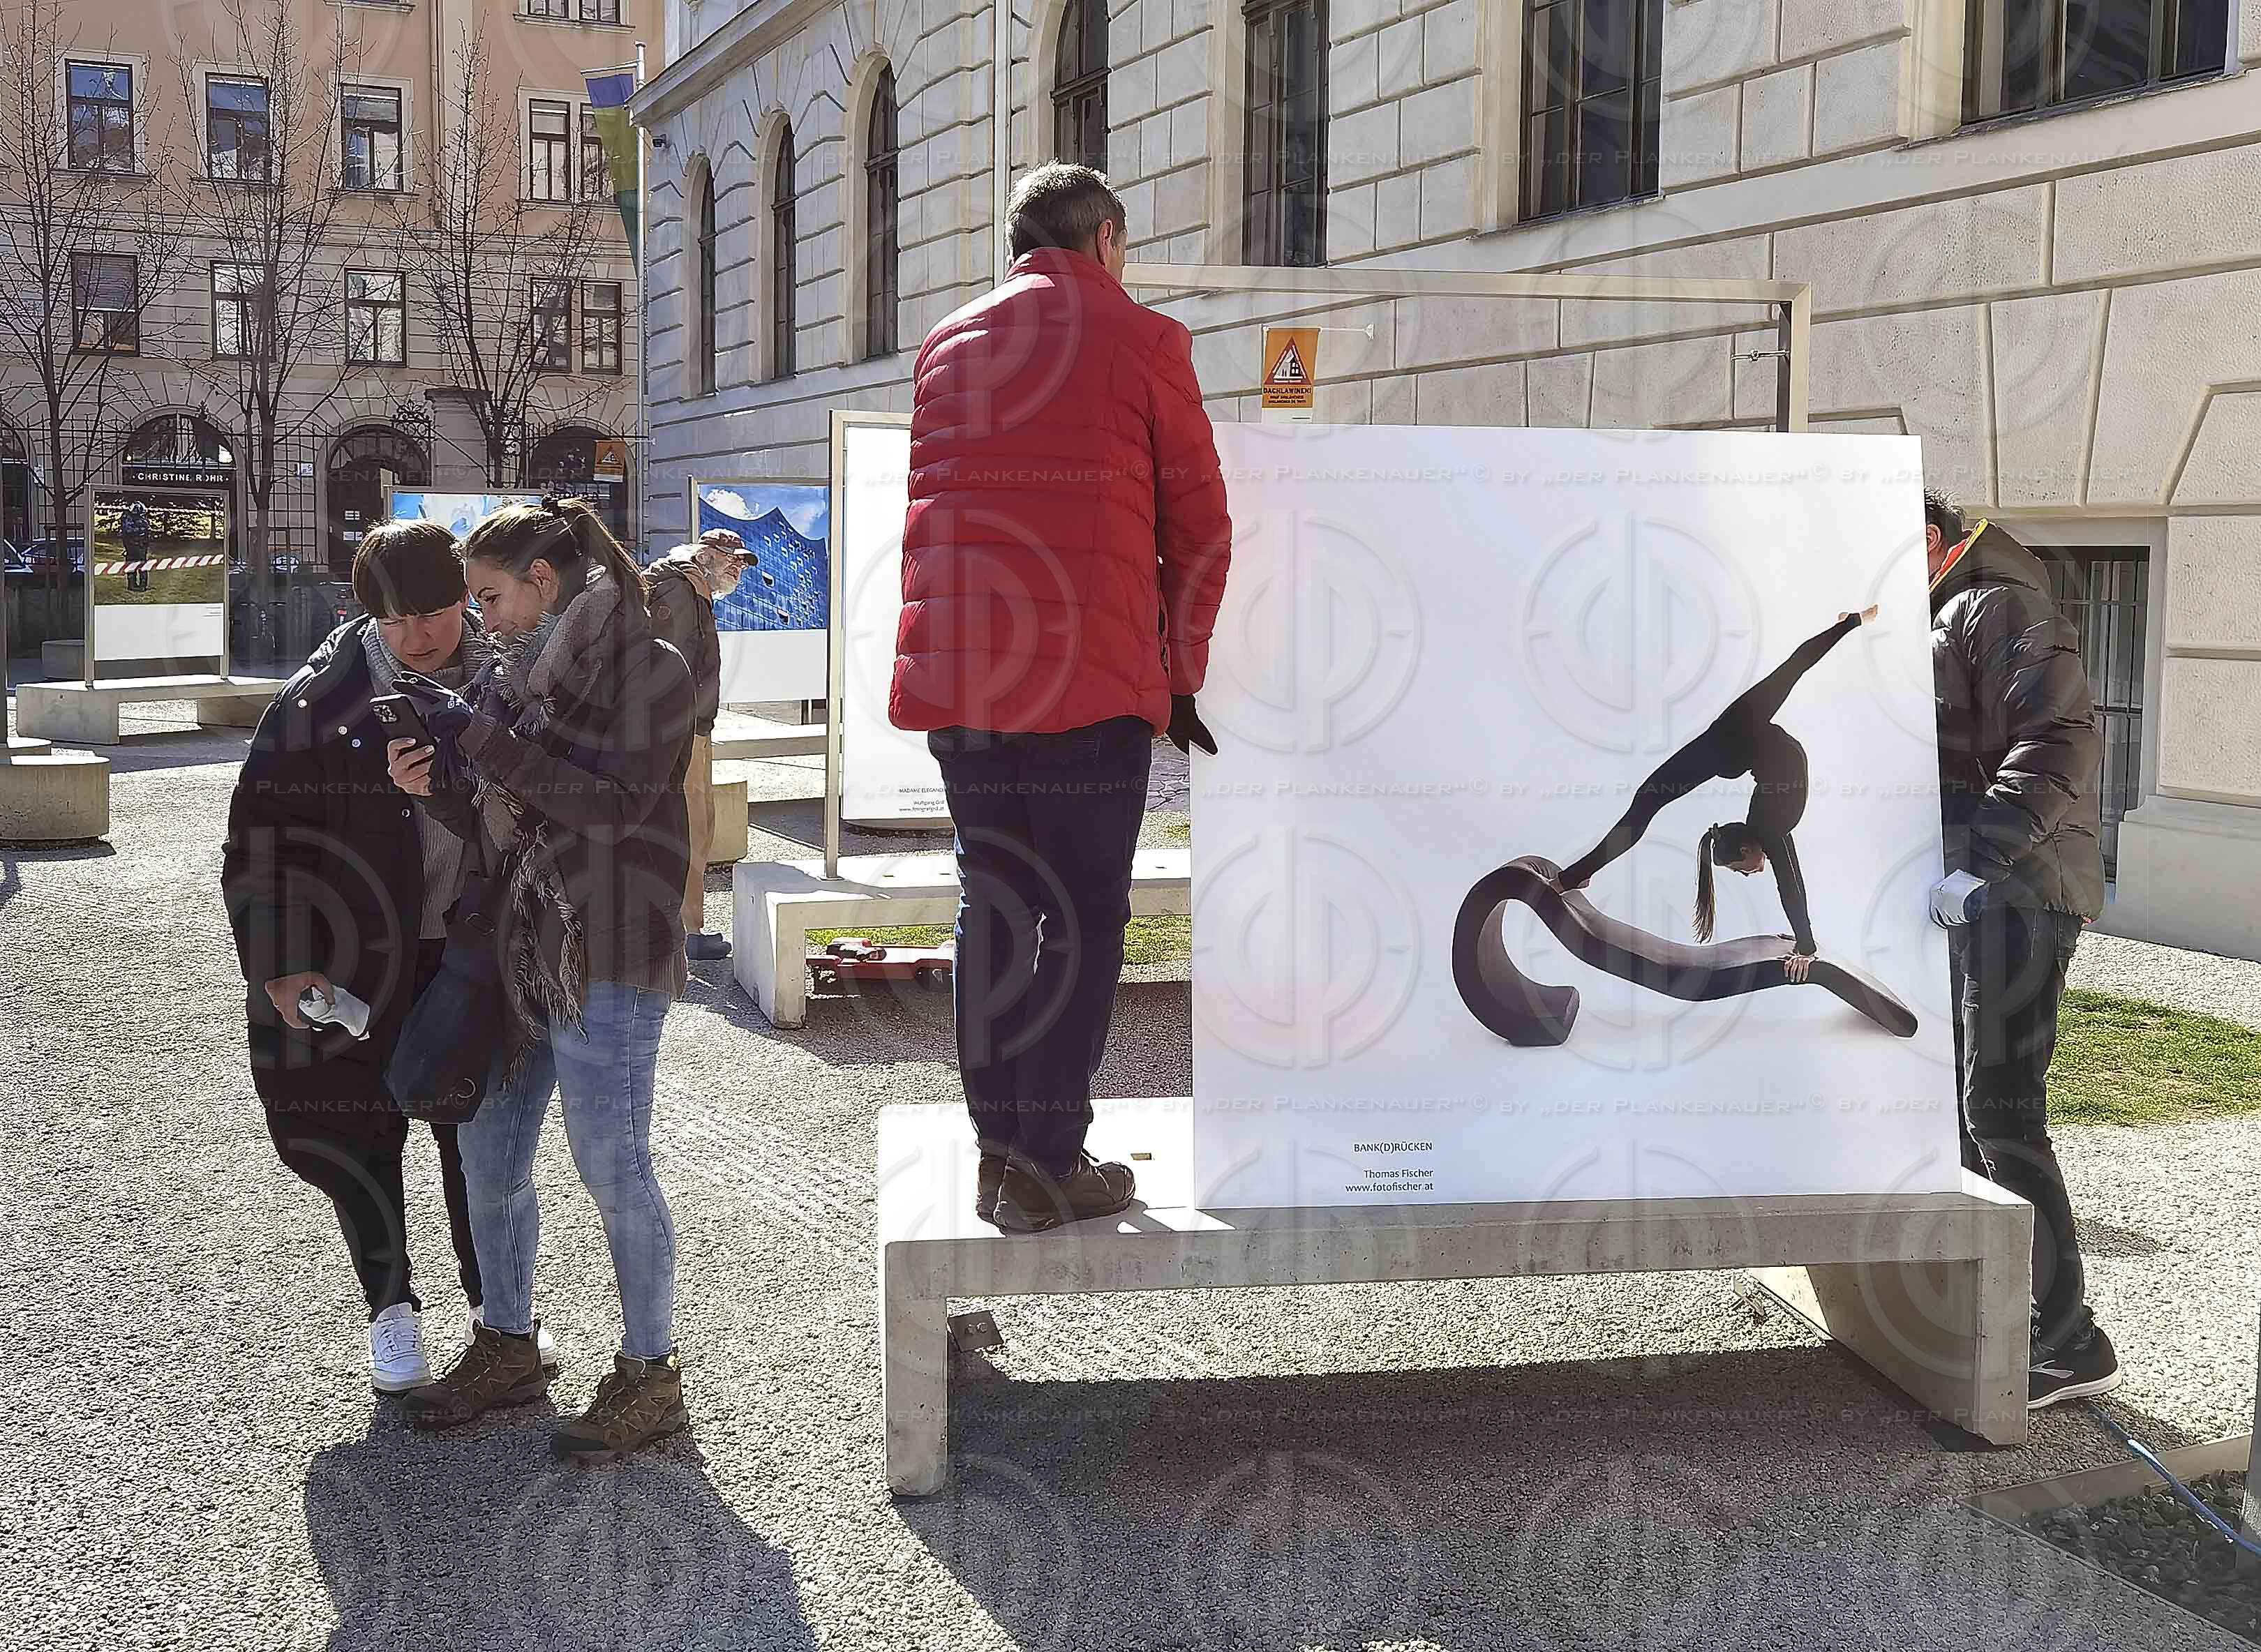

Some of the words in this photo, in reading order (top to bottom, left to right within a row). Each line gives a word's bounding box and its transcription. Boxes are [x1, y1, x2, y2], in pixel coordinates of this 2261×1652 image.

[137, 472, 190, 481] CHRISTINE
[1354, 1141, 1433, 1153] BANK(D)RÜCKEN
[1364, 1170, 1399, 1178] Thomas
[1401, 1169, 1433, 1178] Fischer
[1345, 1182, 1434, 1192] www.fotofischer.at
